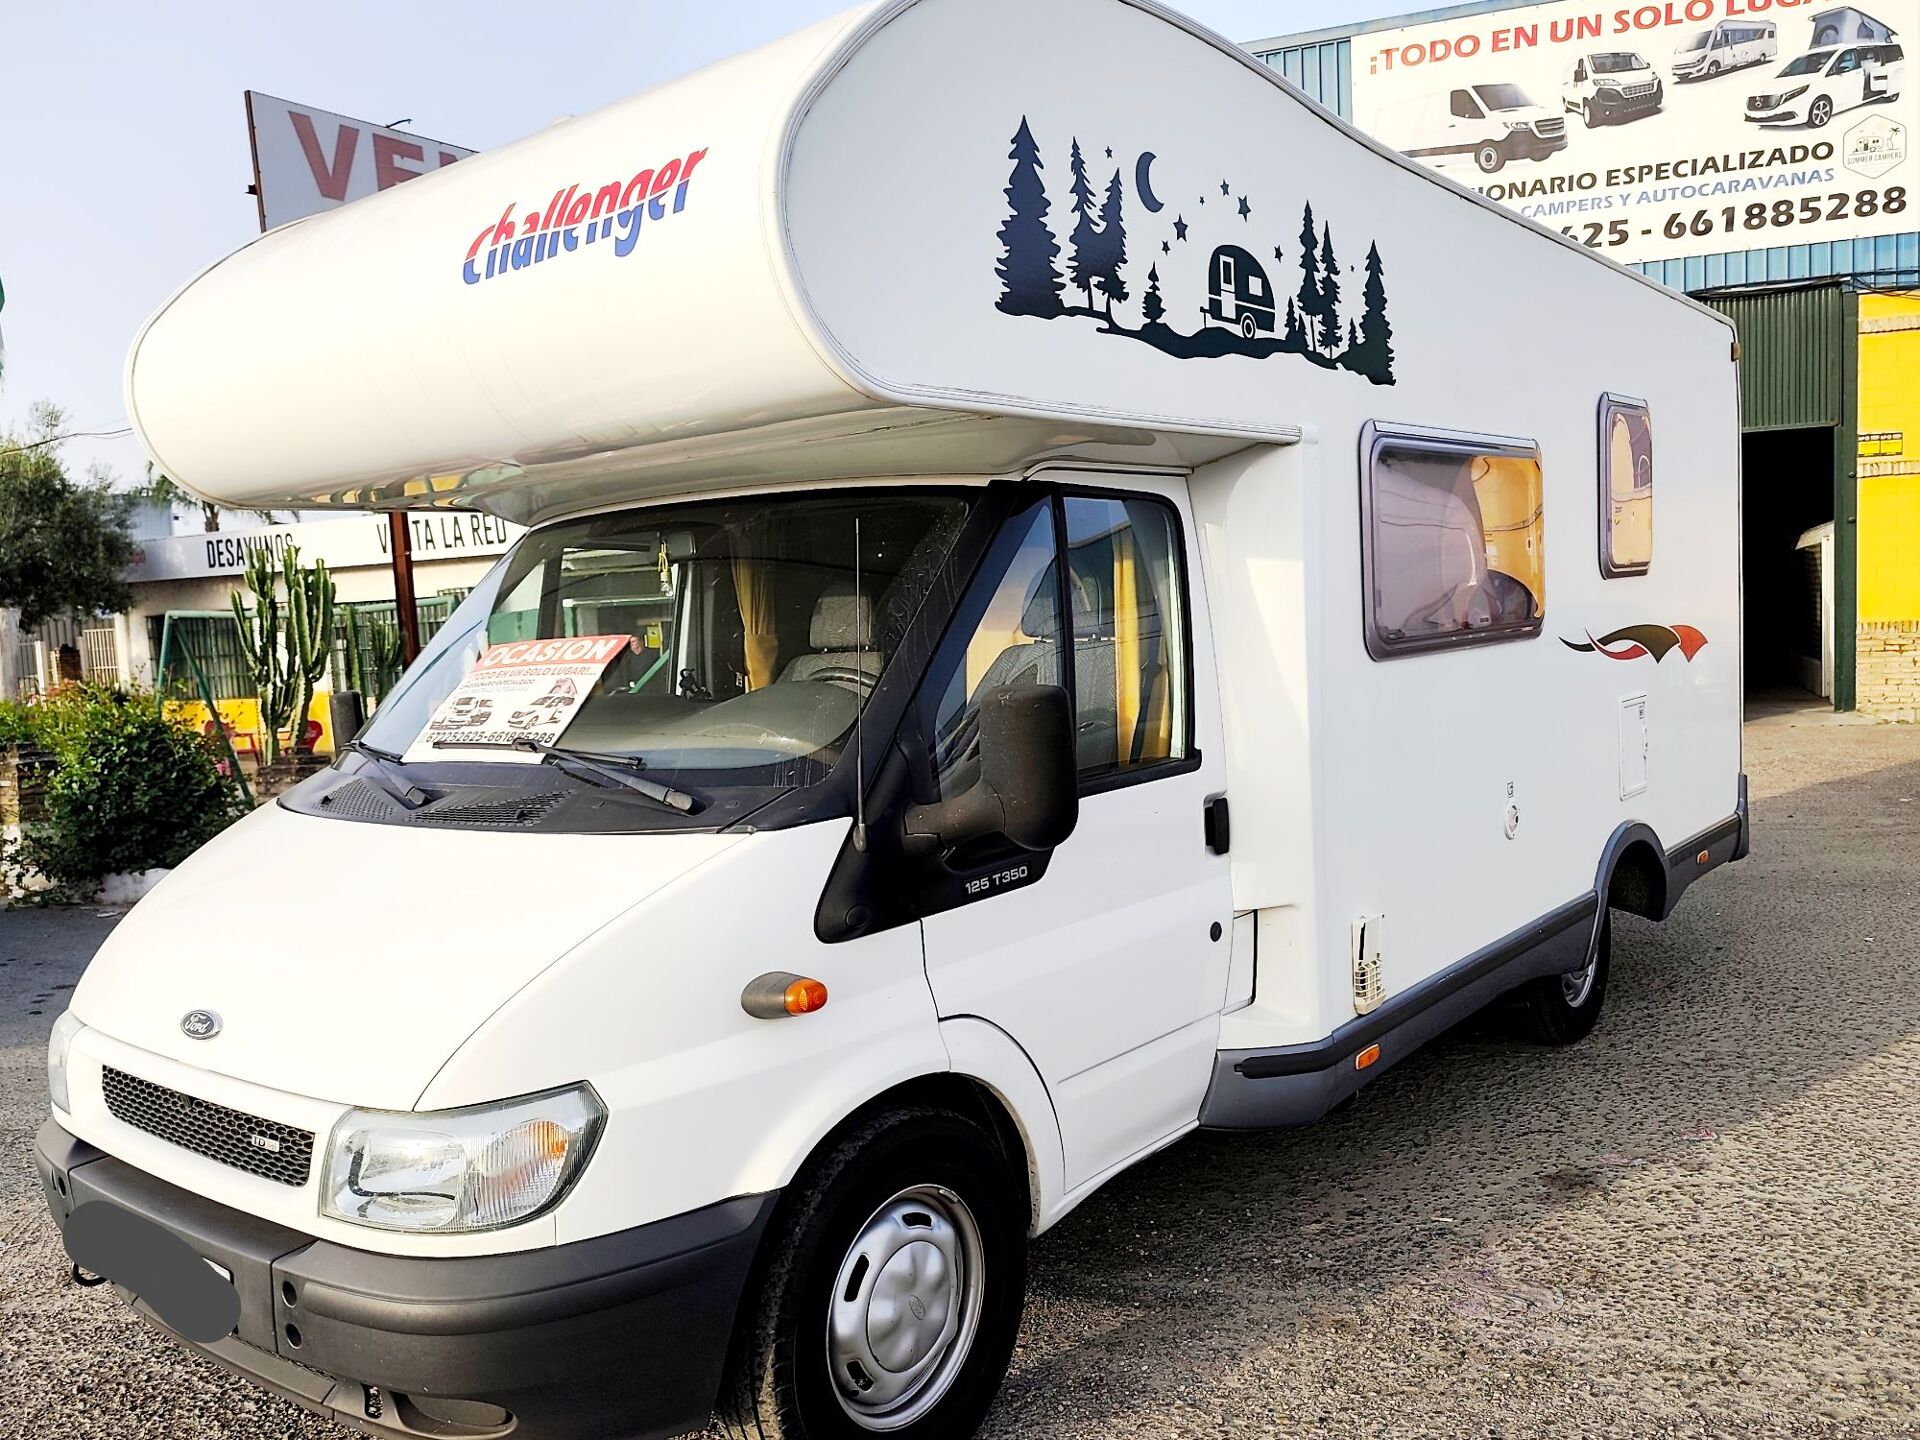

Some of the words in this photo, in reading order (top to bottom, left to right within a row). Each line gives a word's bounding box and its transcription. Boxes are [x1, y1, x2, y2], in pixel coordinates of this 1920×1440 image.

[1370, 34, 1481, 75] ¡TODO
[1491, 24, 1538, 53] EN
[1550, 13, 1602, 43] UN
[1613, 0, 1714, 33] SOLO
[1471, 172, 1598, 202] IONARIO
[1605, 141, 1835, 187] ESPECIALIZADO
[1846, 155, 1873, 165] SUMMER
[1874, 151, 1903, 161] CAMPERS
[1520, 195, 1614, 218] CAMPERS
[1617, 192, 1632, 207] Y
[1636, 167, 1836, 204] AUTOCARAVANAS
[1663, 185, 1908, 240] 661885288
[441, 516, 466, 550] LA
[472, 513, 508, 546] RED
[483, 638, 616, 667] OCASION
[965, 877, 990, 894] 125
[992, 865, 1028, 886] T350
